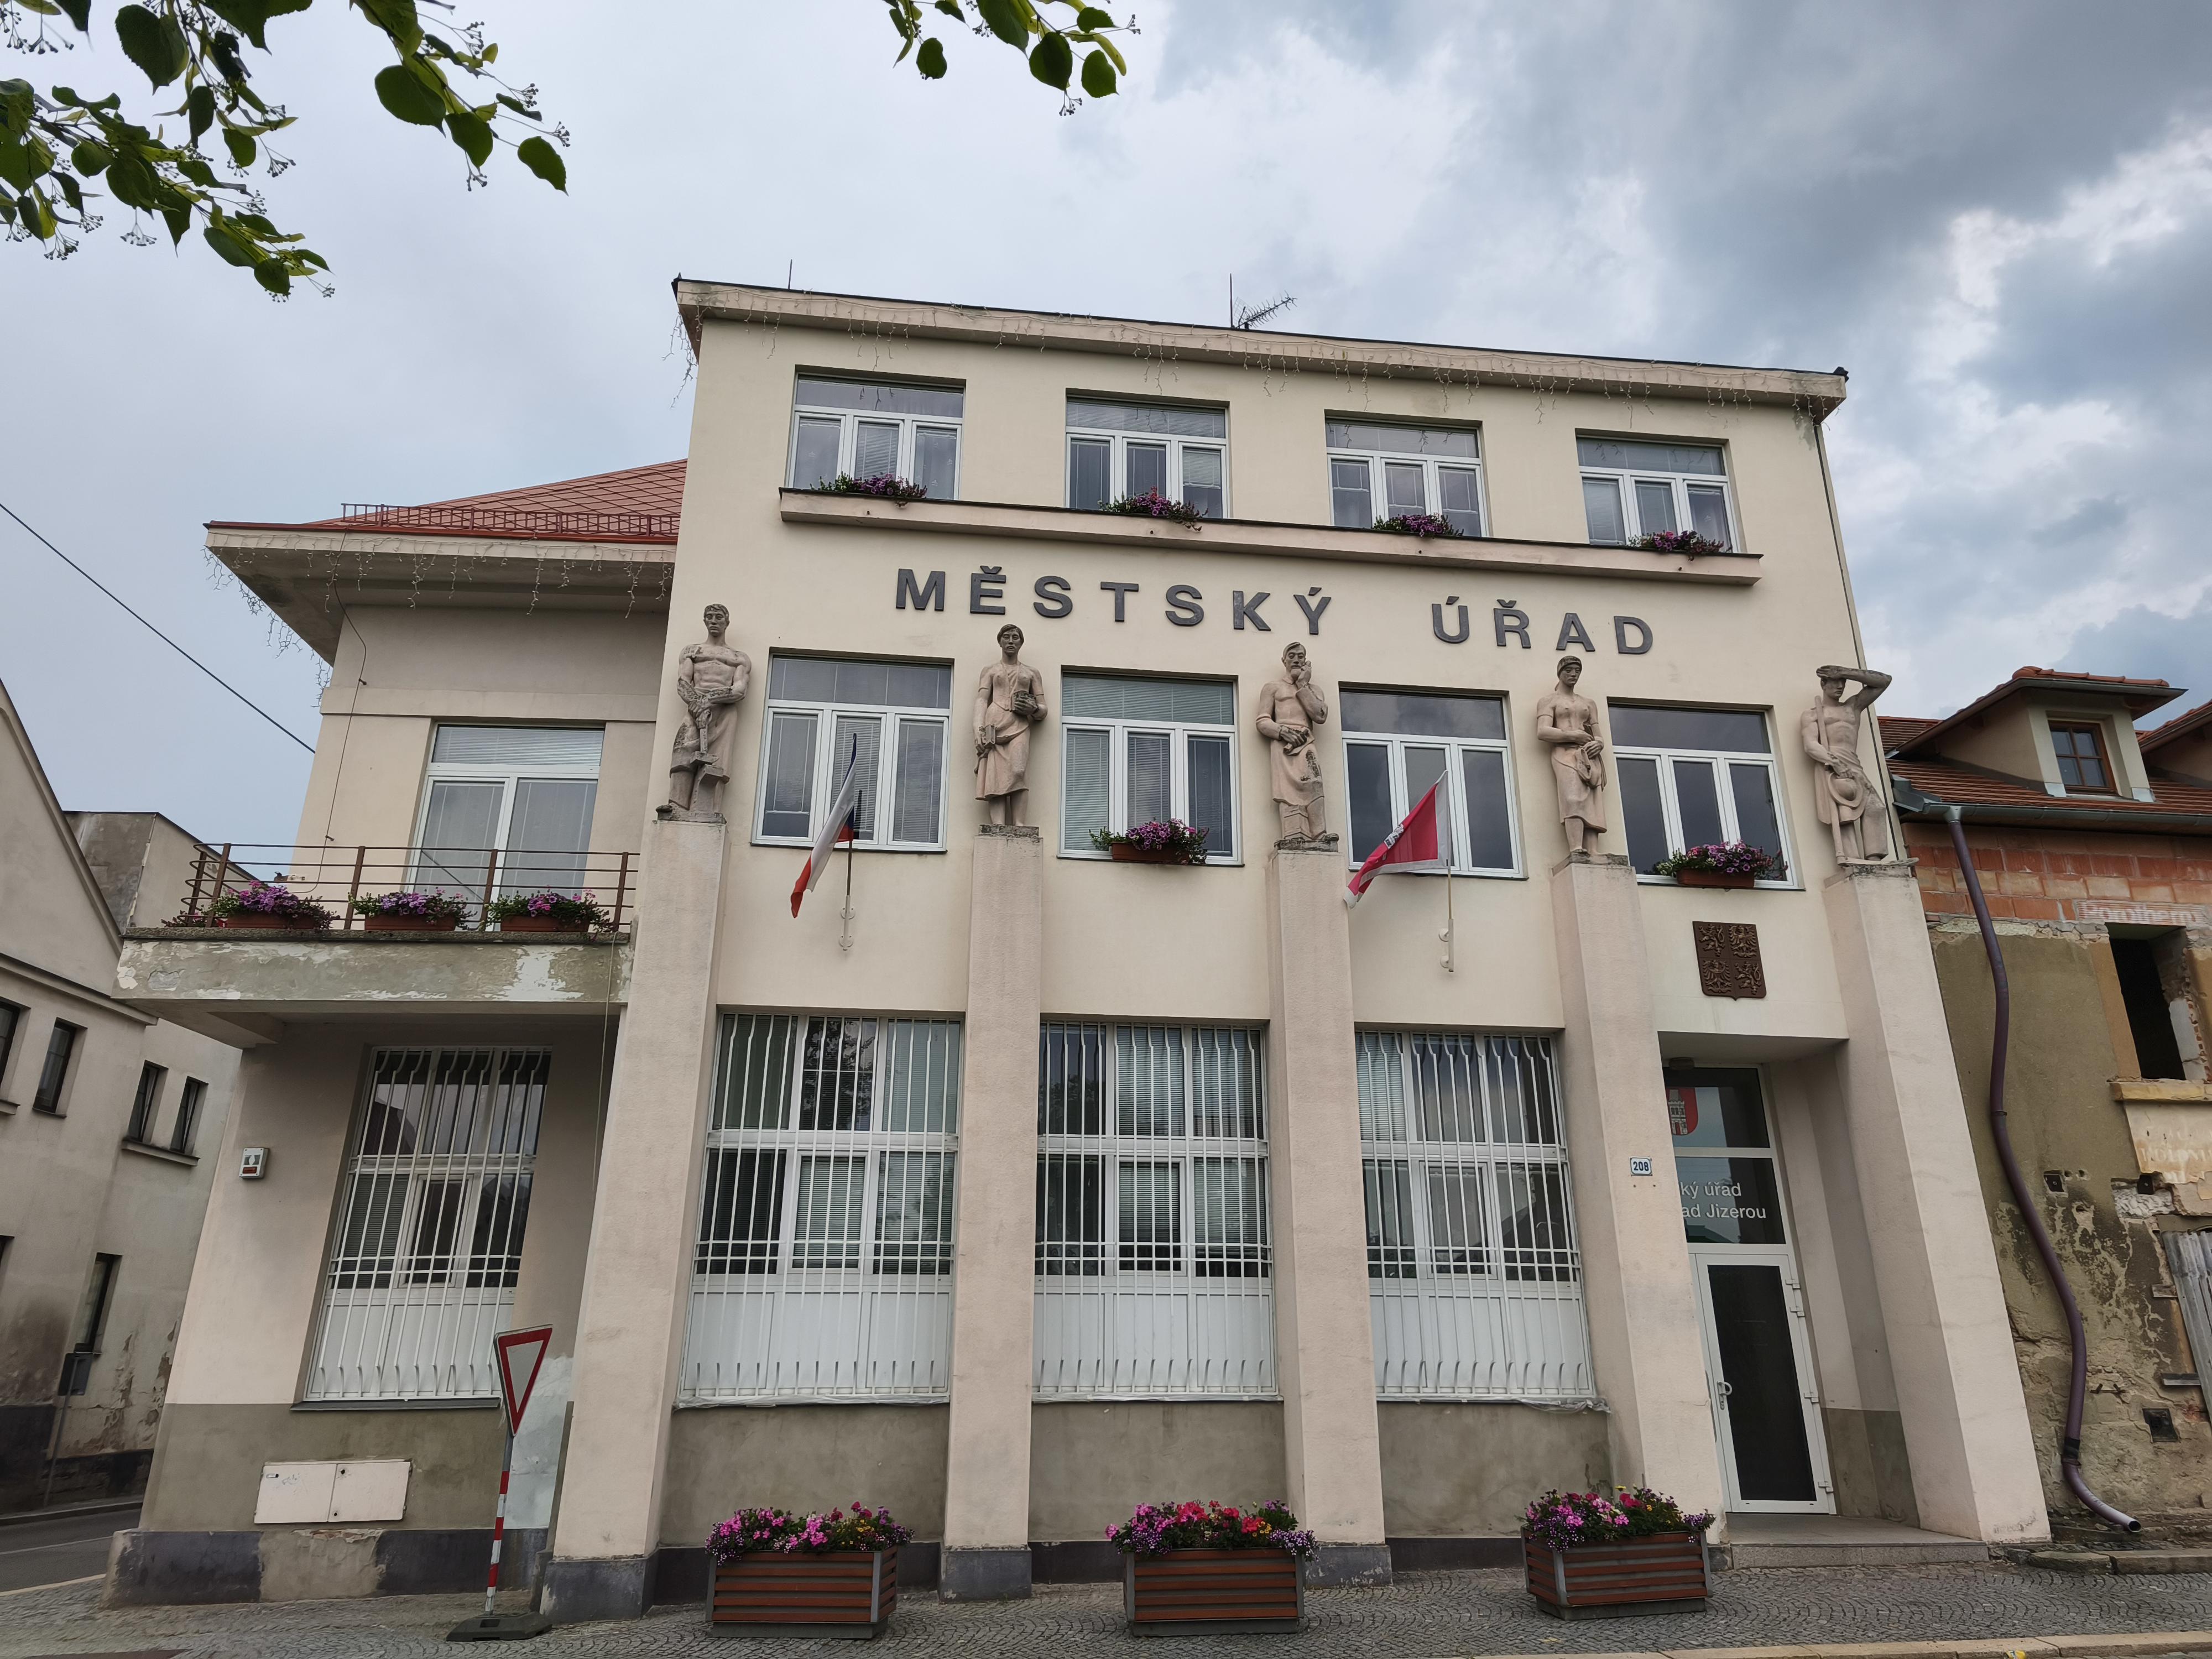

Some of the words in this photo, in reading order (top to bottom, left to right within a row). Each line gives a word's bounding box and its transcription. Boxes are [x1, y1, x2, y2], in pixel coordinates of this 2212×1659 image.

[896, 565, 1331, 635] MĚSTSKÝ
[1431, 596, 1654, 655] ÚŘAD
[1633, 1161, 1649, 1171] 208
[1680, 1181, 1698, 1199] ký
[1704, 1181, 1741, 1196] úřad
[1682, 1204, 1700, 1217] ad
[1706, 1204, 1766, 1218] Jizerou
